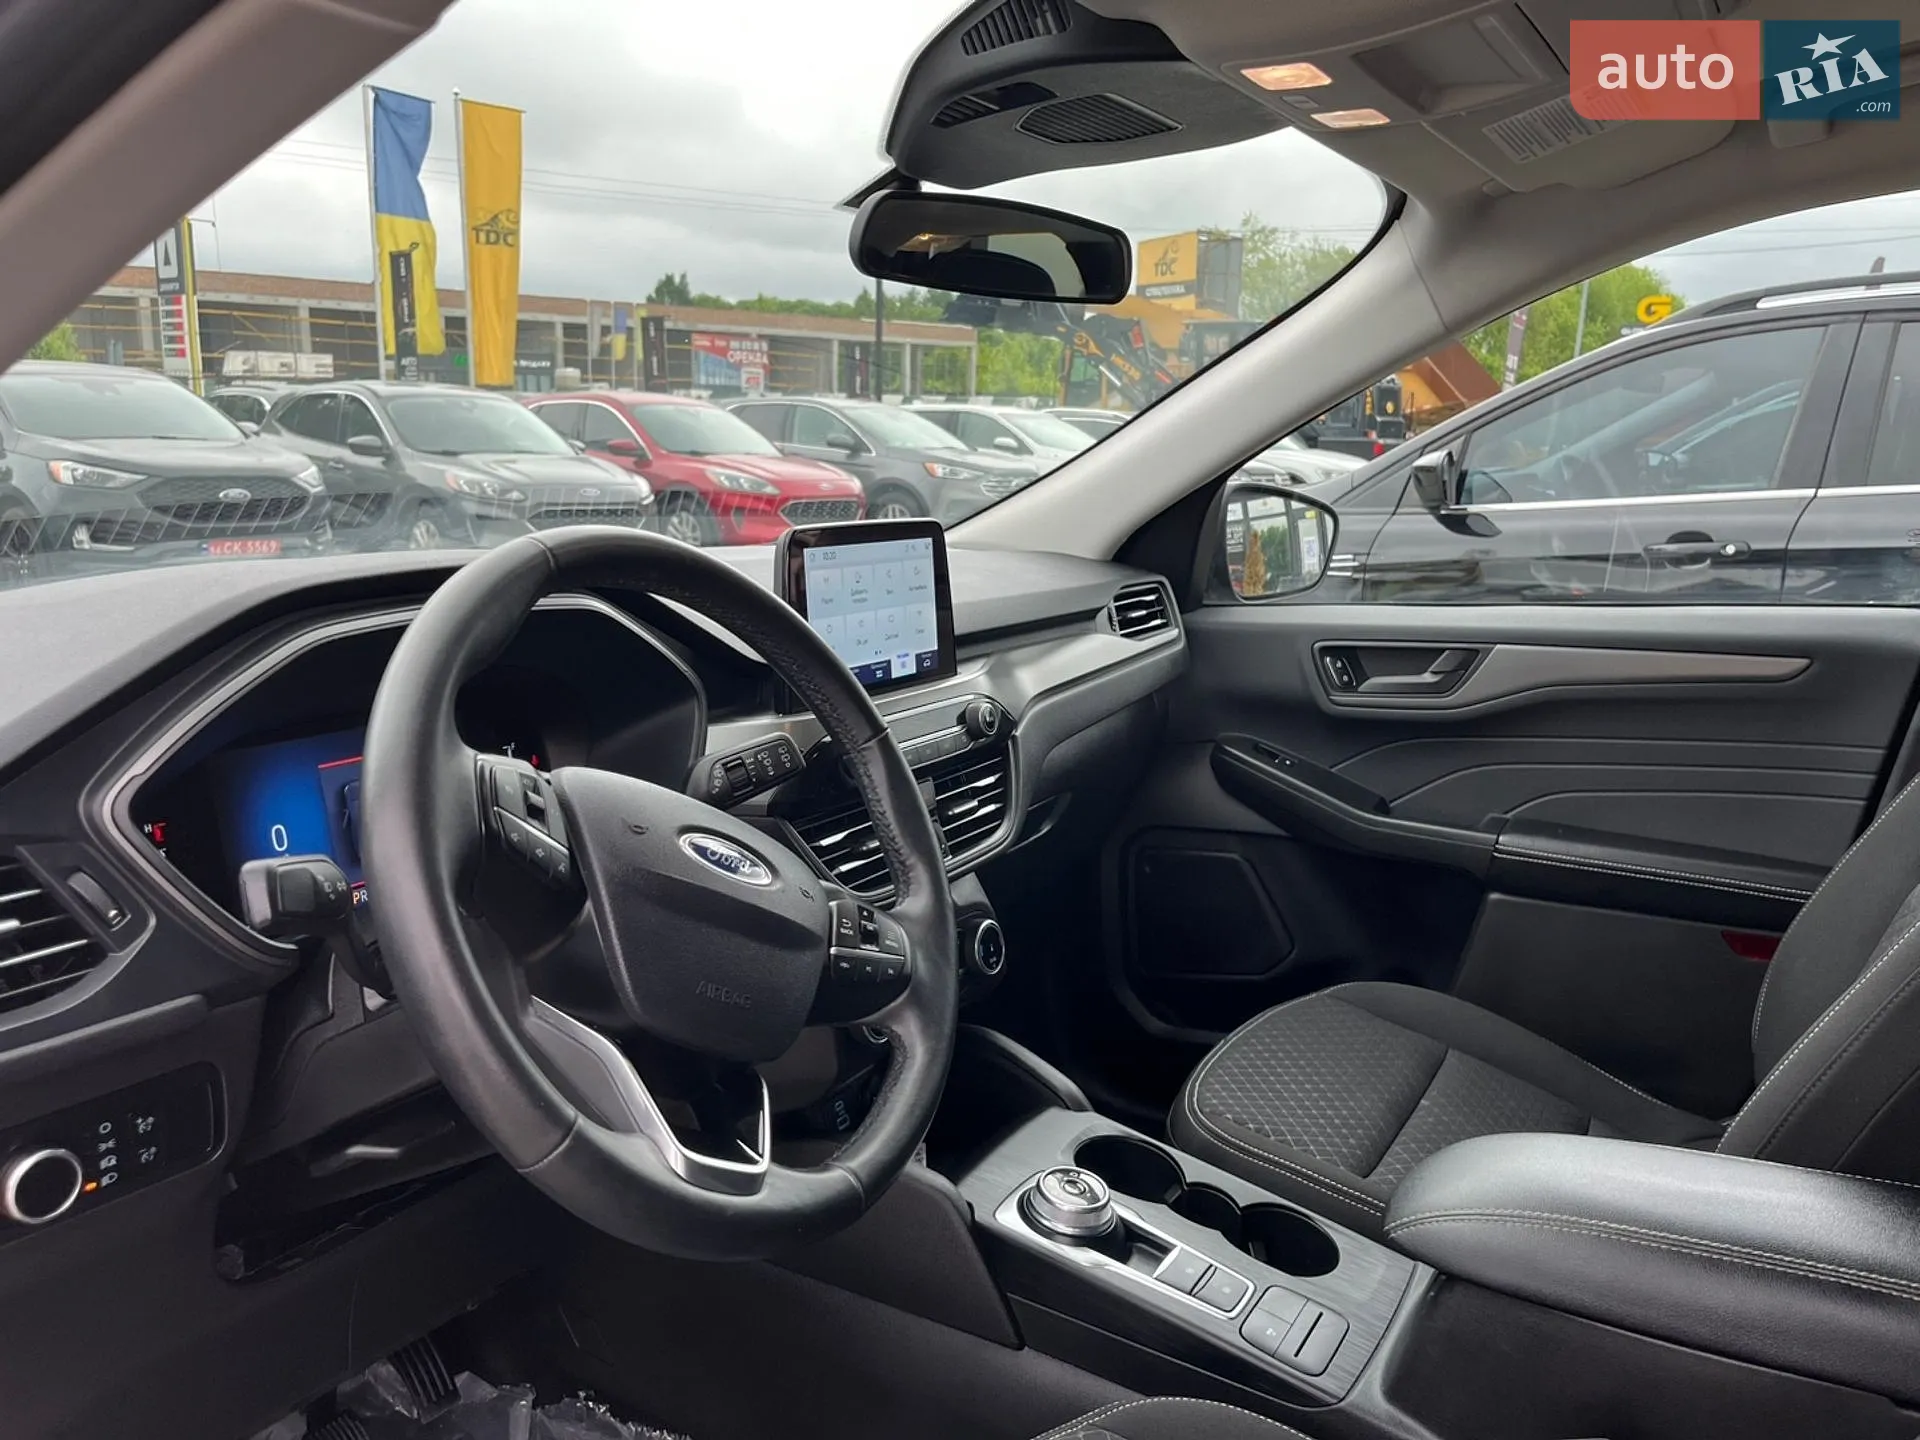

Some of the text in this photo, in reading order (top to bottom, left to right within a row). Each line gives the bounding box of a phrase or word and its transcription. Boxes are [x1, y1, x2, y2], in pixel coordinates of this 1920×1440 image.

[472, 227, 516, 248] TDC
[1153, 256, 1179, 277] TDC
[271, 823, 289, 852] 0
